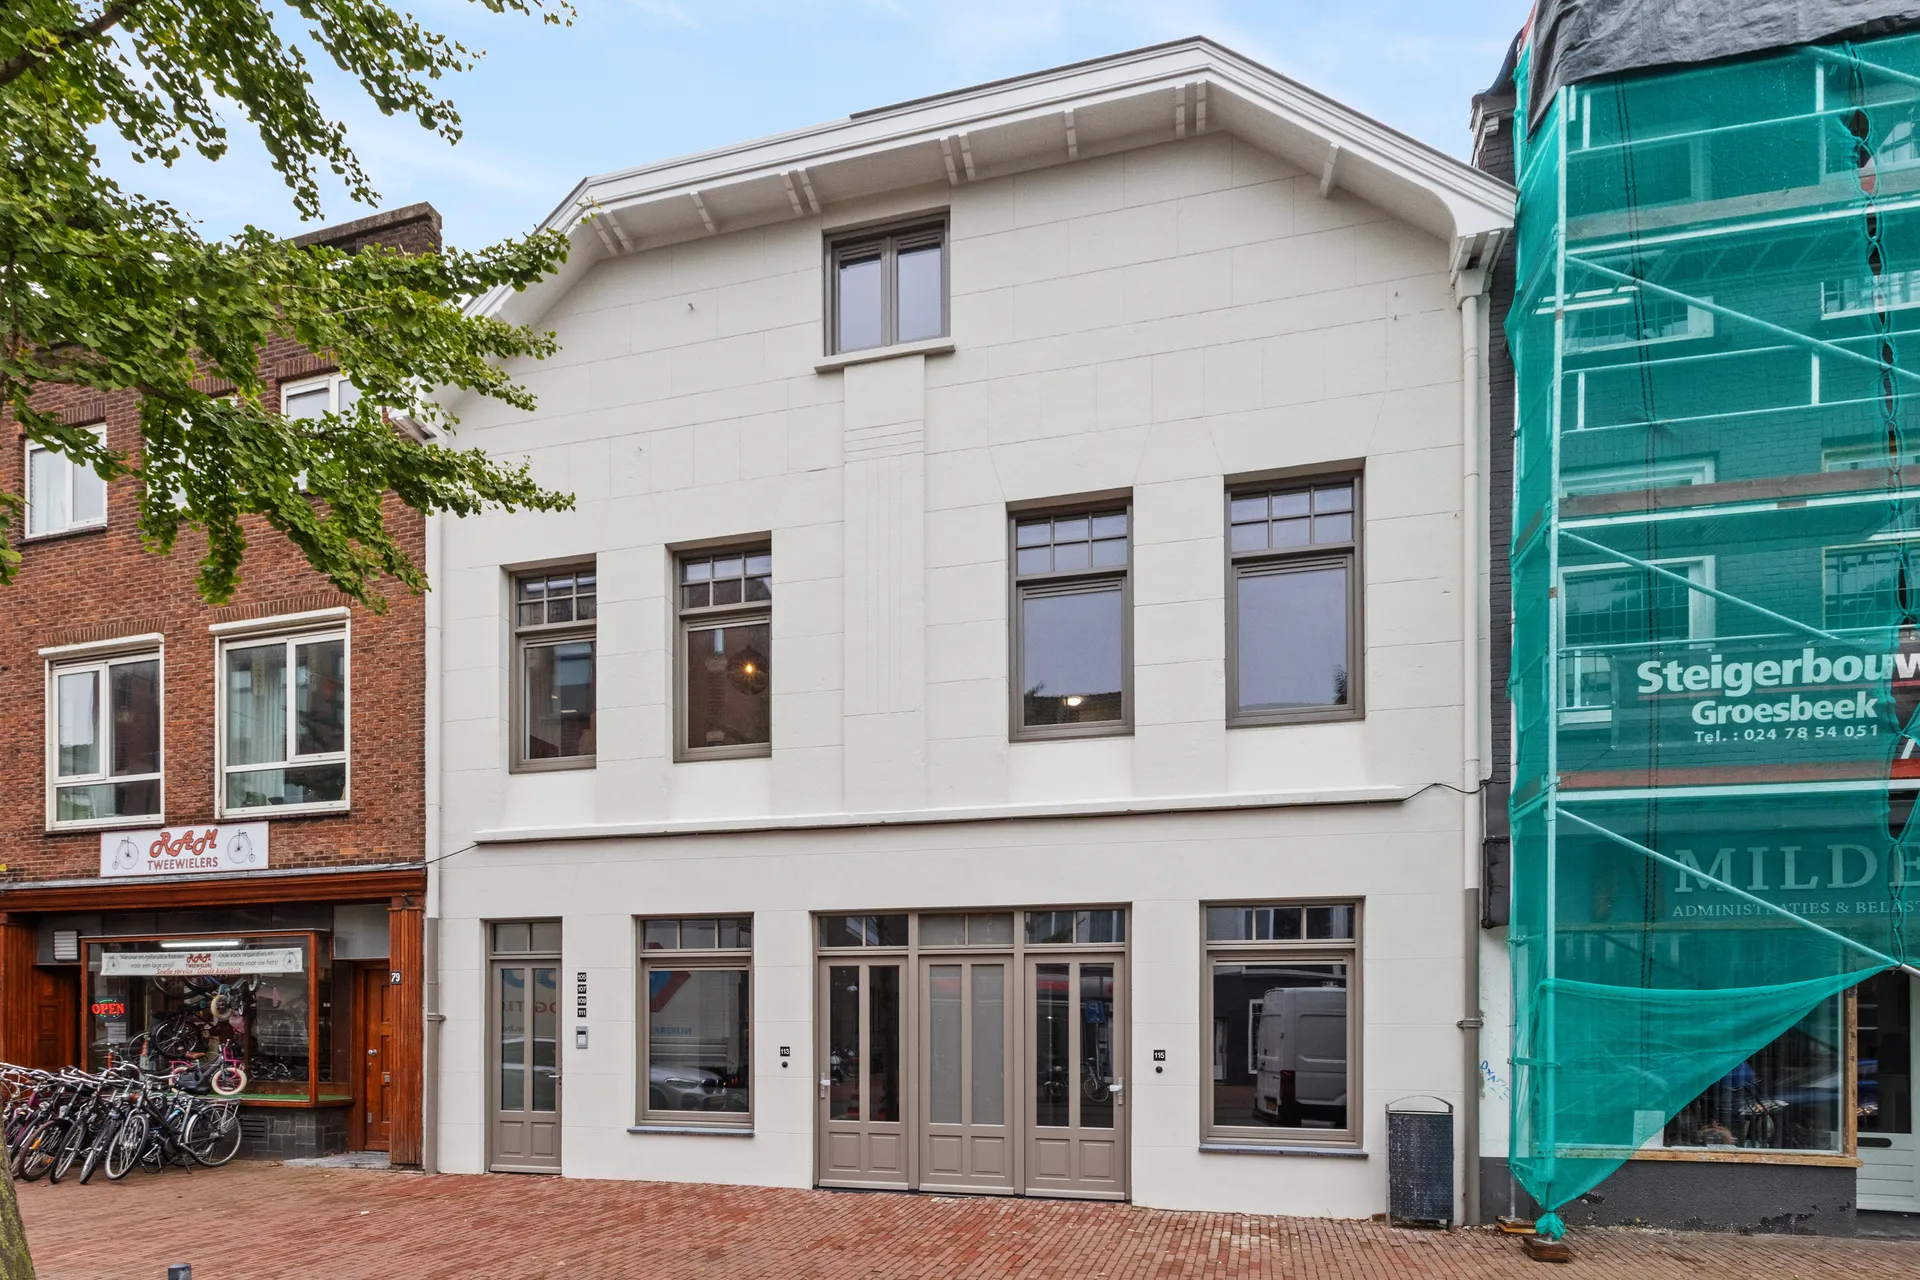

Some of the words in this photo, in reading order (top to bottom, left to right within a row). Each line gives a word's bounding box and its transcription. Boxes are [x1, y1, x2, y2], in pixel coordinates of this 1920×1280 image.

[1637, 648, 1920, 697] Steigerbouw
[1691, 691, 1879, 725] Groesbeek
[1694, 731, 1727, 743] Tel.
[1744, 728, 1777, 741] 024
[1785, 727, 1808, 739] 78
[1815, 726, 1837, 738] 54
[1844, 724, 1878, 737] 051
[149, 828, 218, 858] RAM
[147, 857, 218, 871] TWEEWIELERS
[1672, 901, 1829, 918] ADMINISTATIES
[1836, 901, 1850, 914] &
[391, 972, 401, 983] 79
[91, 1003, 125, 1015] OPEN
[1154, 1051, 1165, 1059] 115
